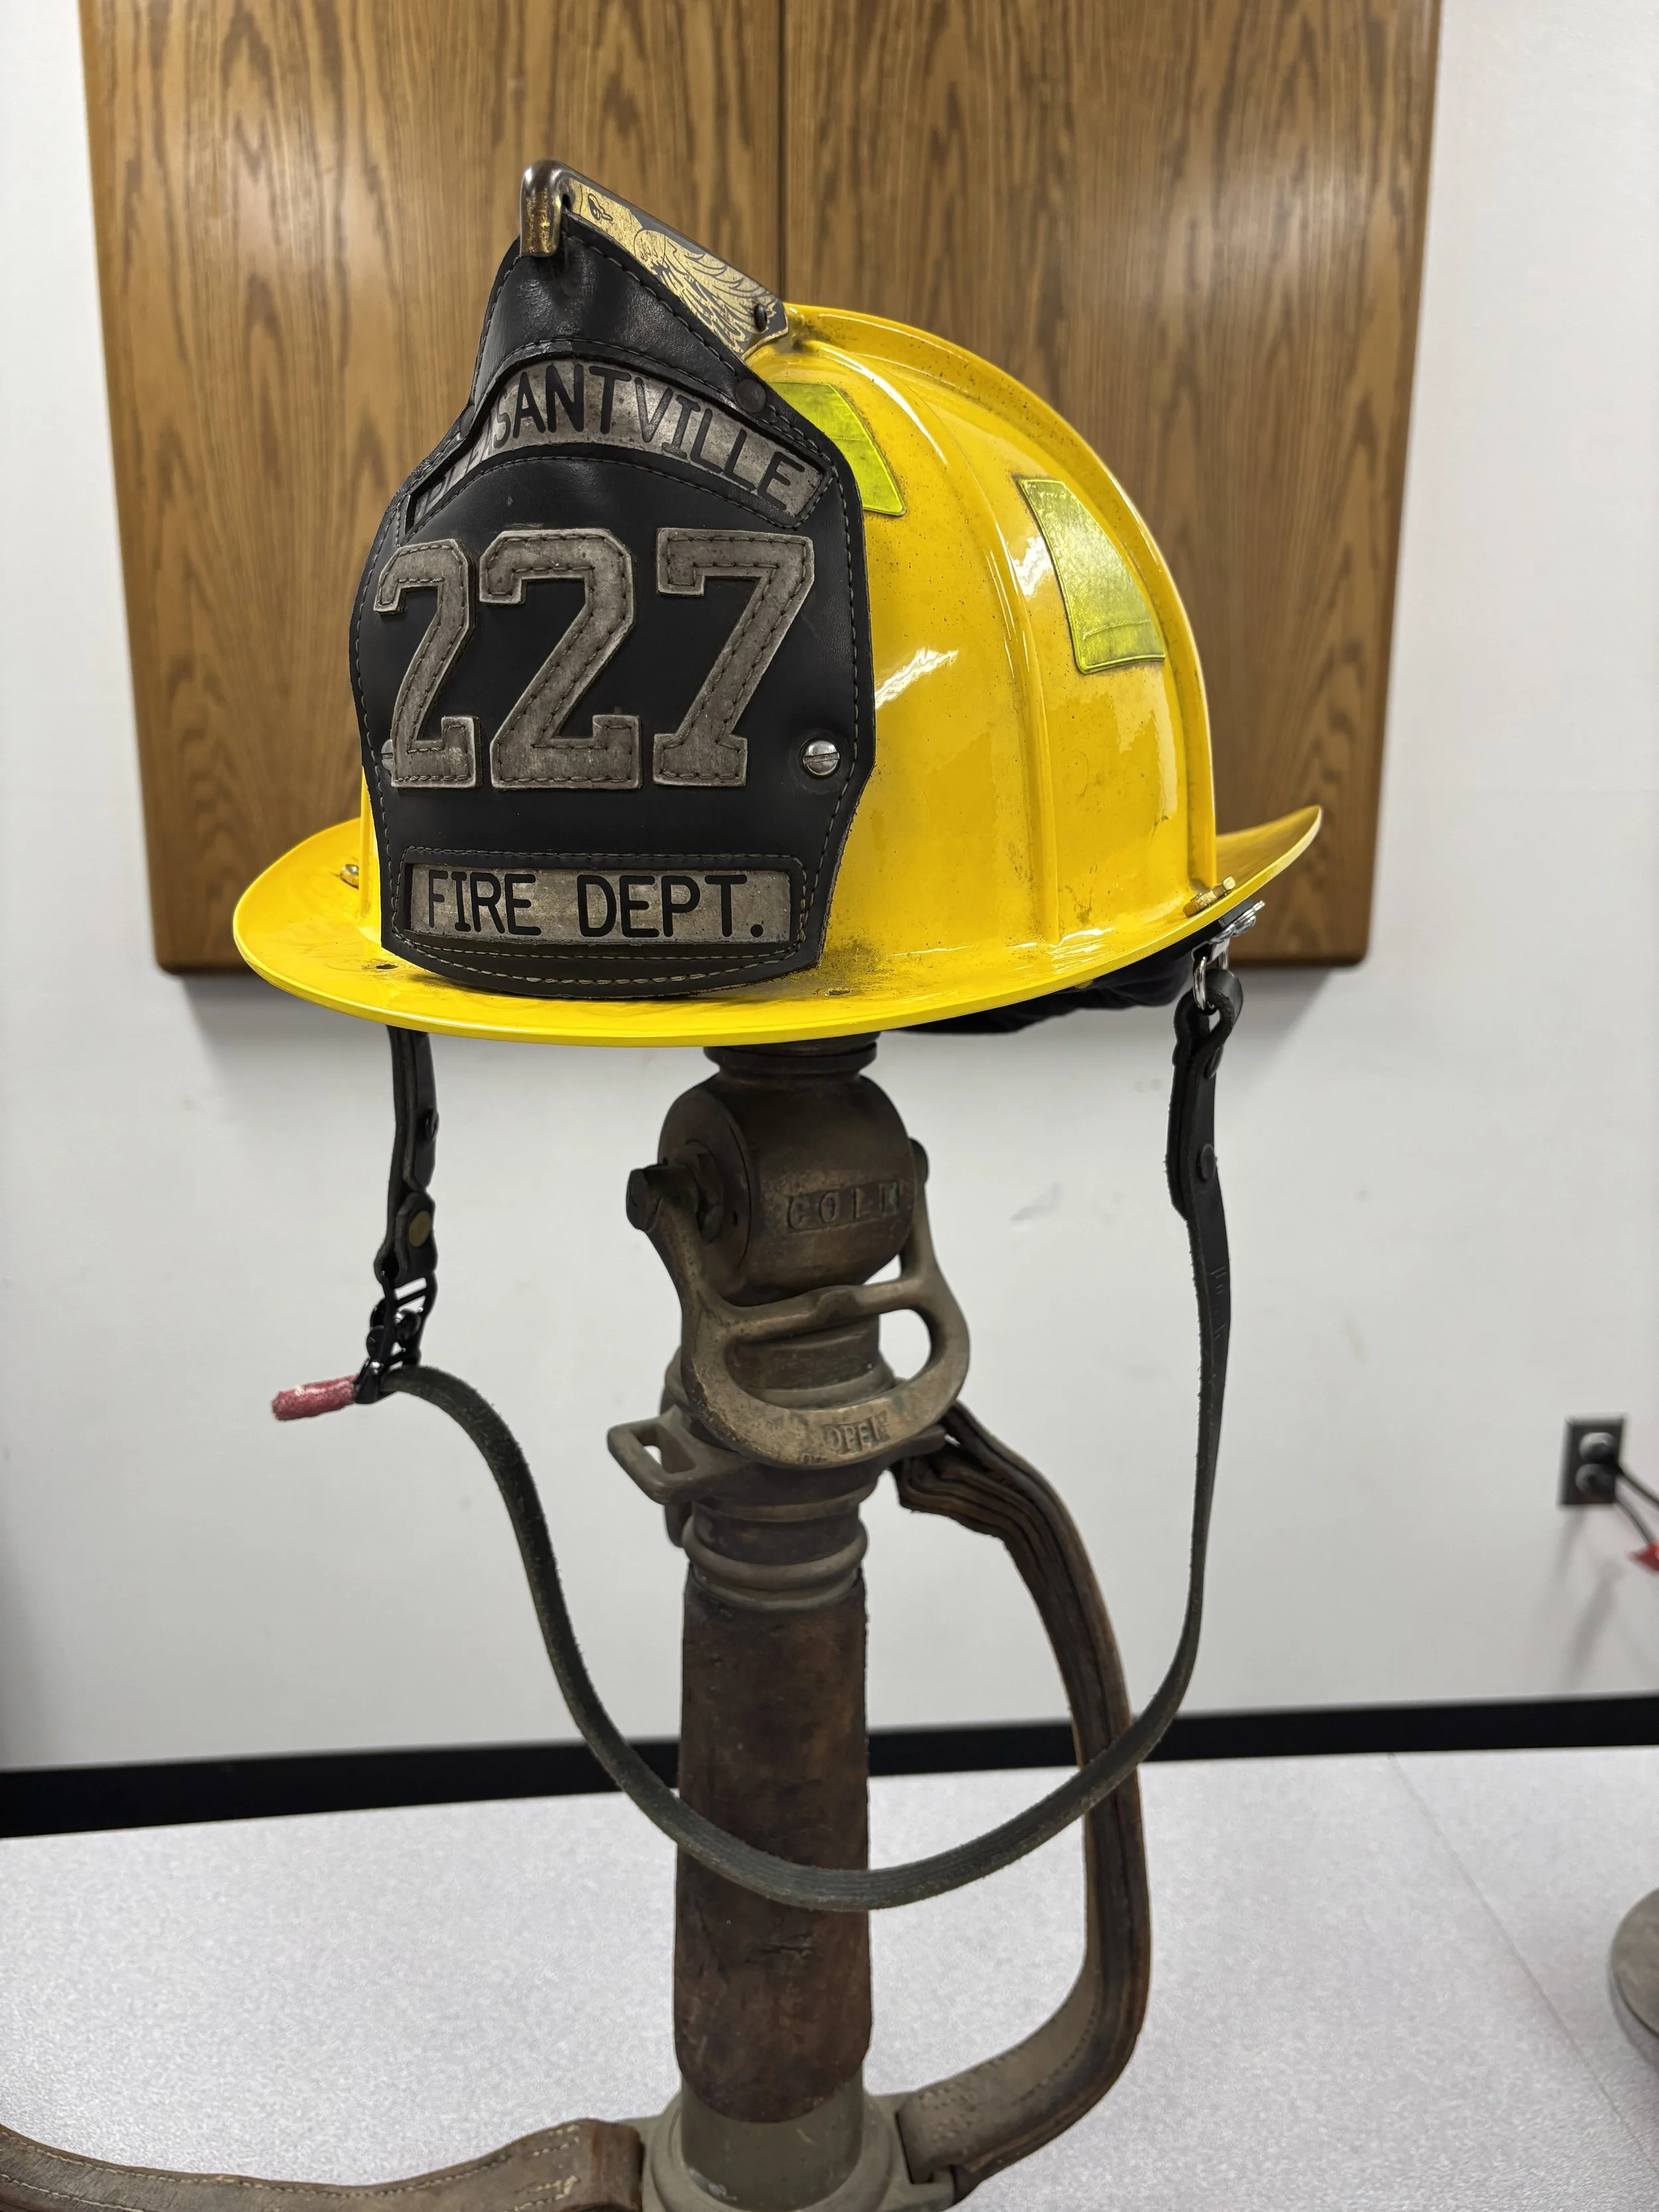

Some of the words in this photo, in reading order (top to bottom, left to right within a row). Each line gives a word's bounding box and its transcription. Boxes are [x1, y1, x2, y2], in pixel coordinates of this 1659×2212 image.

[374, 528, 815, 789] 227
[427, 870, 541, 937] FIRE
[577, 873, 764, 938] DEPT.
